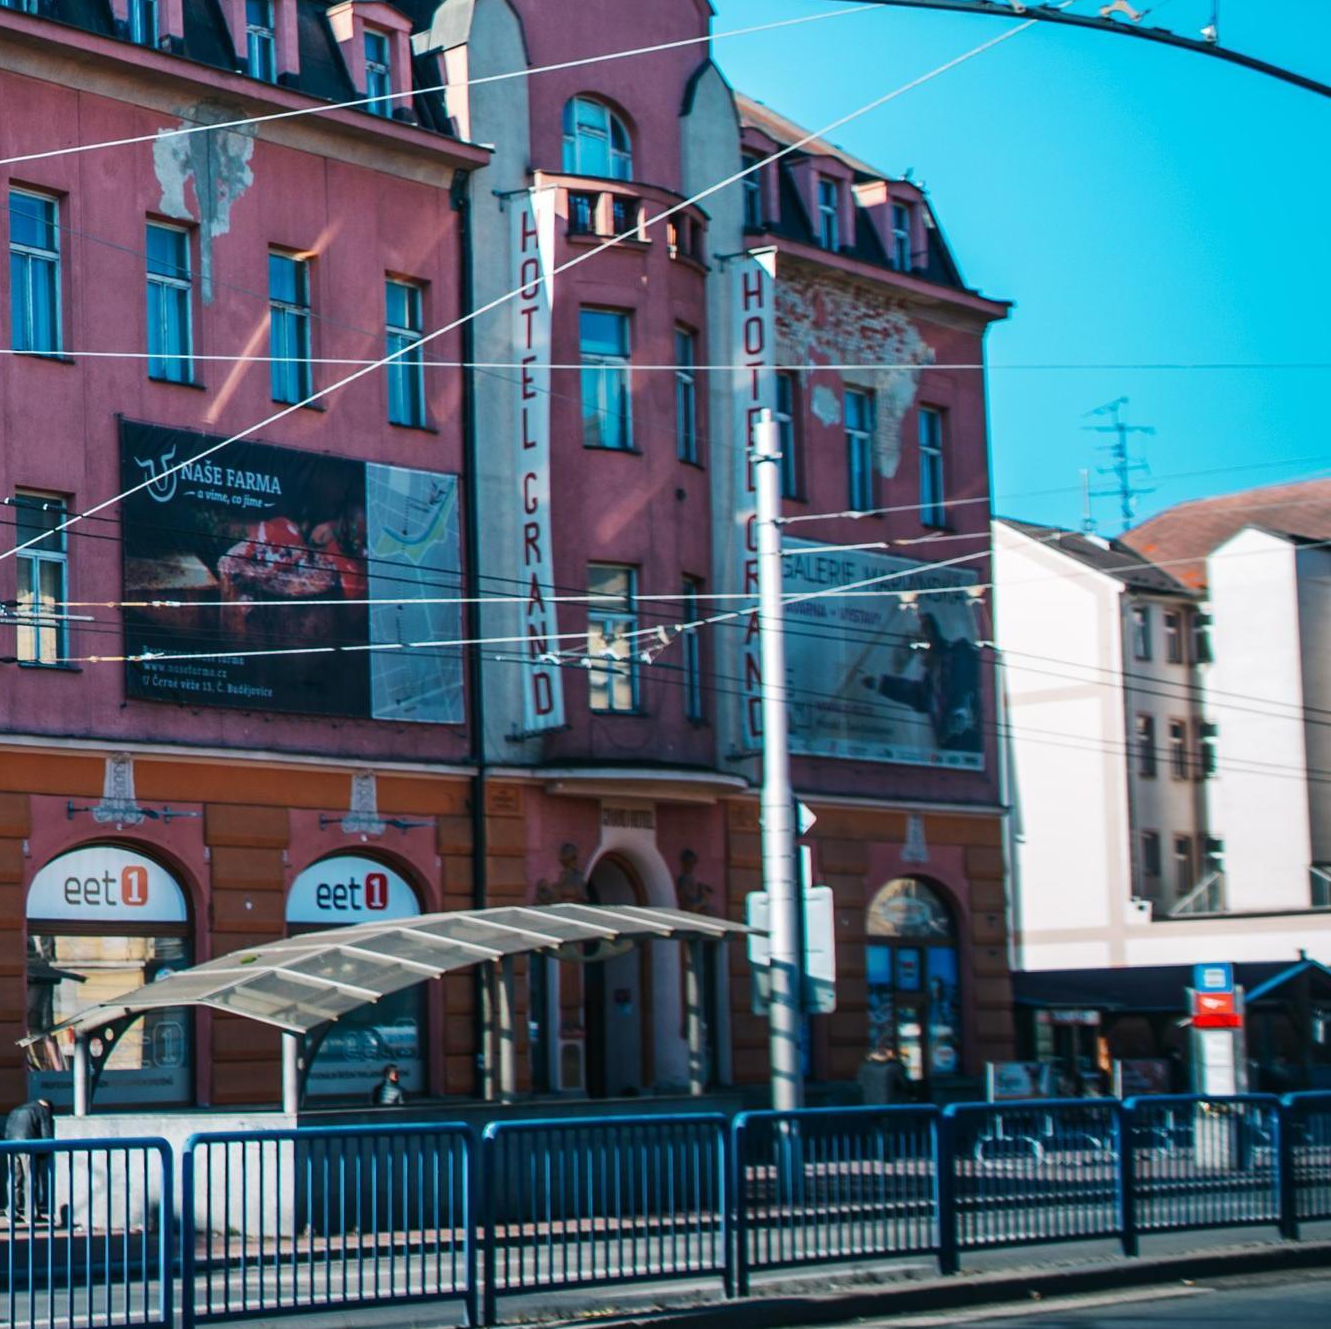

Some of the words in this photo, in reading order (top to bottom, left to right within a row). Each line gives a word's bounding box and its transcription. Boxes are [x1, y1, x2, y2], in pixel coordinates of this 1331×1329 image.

[521, 208, 539, 451] HOTEL
[180, 459, 223, 486] NAŠE
[225, 468, 282, 495] FARMA
[524, 471, 553, 717] GRAND
[64, 870, 117, 906] eet
[127, 870, 142, 903] 1
[317, 876, 362, 910] eet
[369, 876, 387, 909] 1
